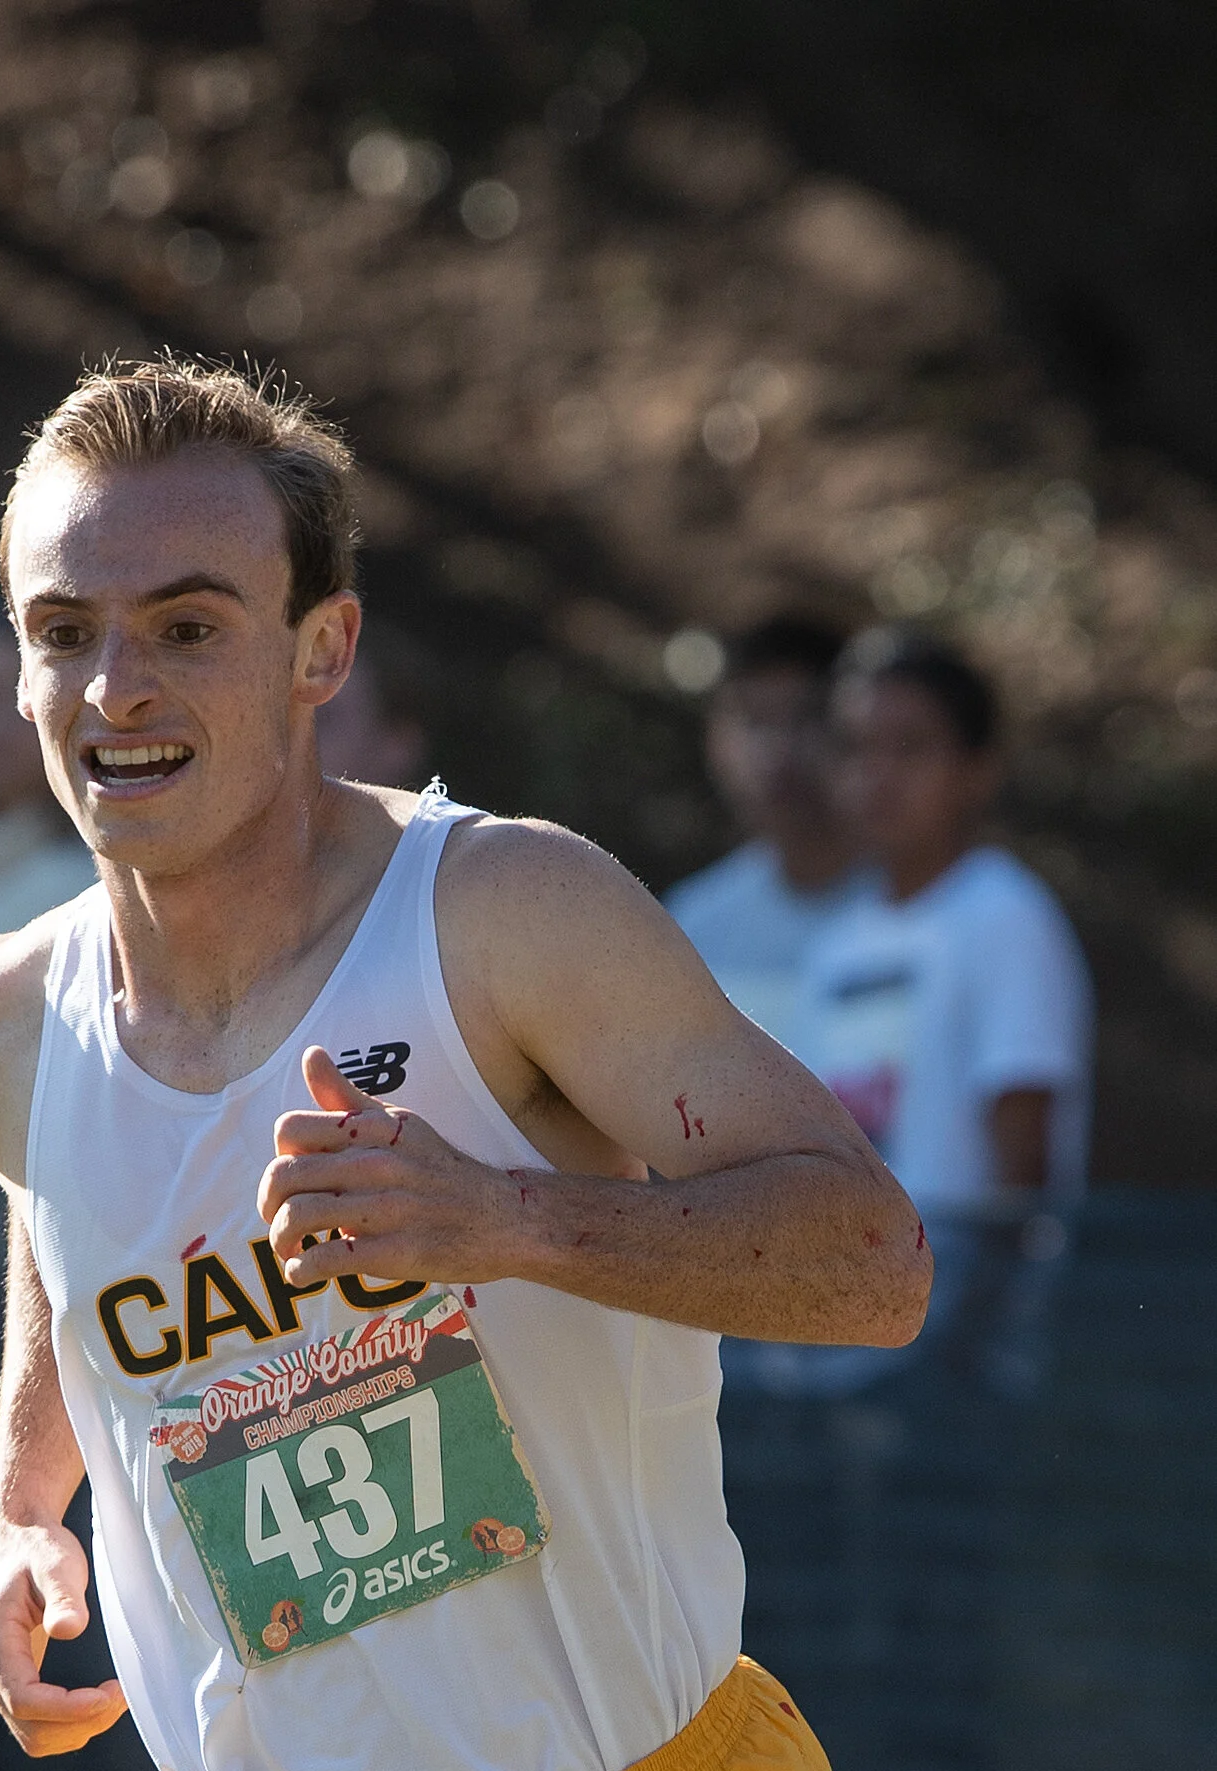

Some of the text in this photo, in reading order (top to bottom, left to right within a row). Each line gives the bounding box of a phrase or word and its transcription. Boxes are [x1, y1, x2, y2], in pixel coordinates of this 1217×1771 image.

[200, 1318, 429, 1435] Orange County
[243, 1365, 417, 1451] CHAMPIONSHIPS
[244, 1387, 447, 1581] 437
